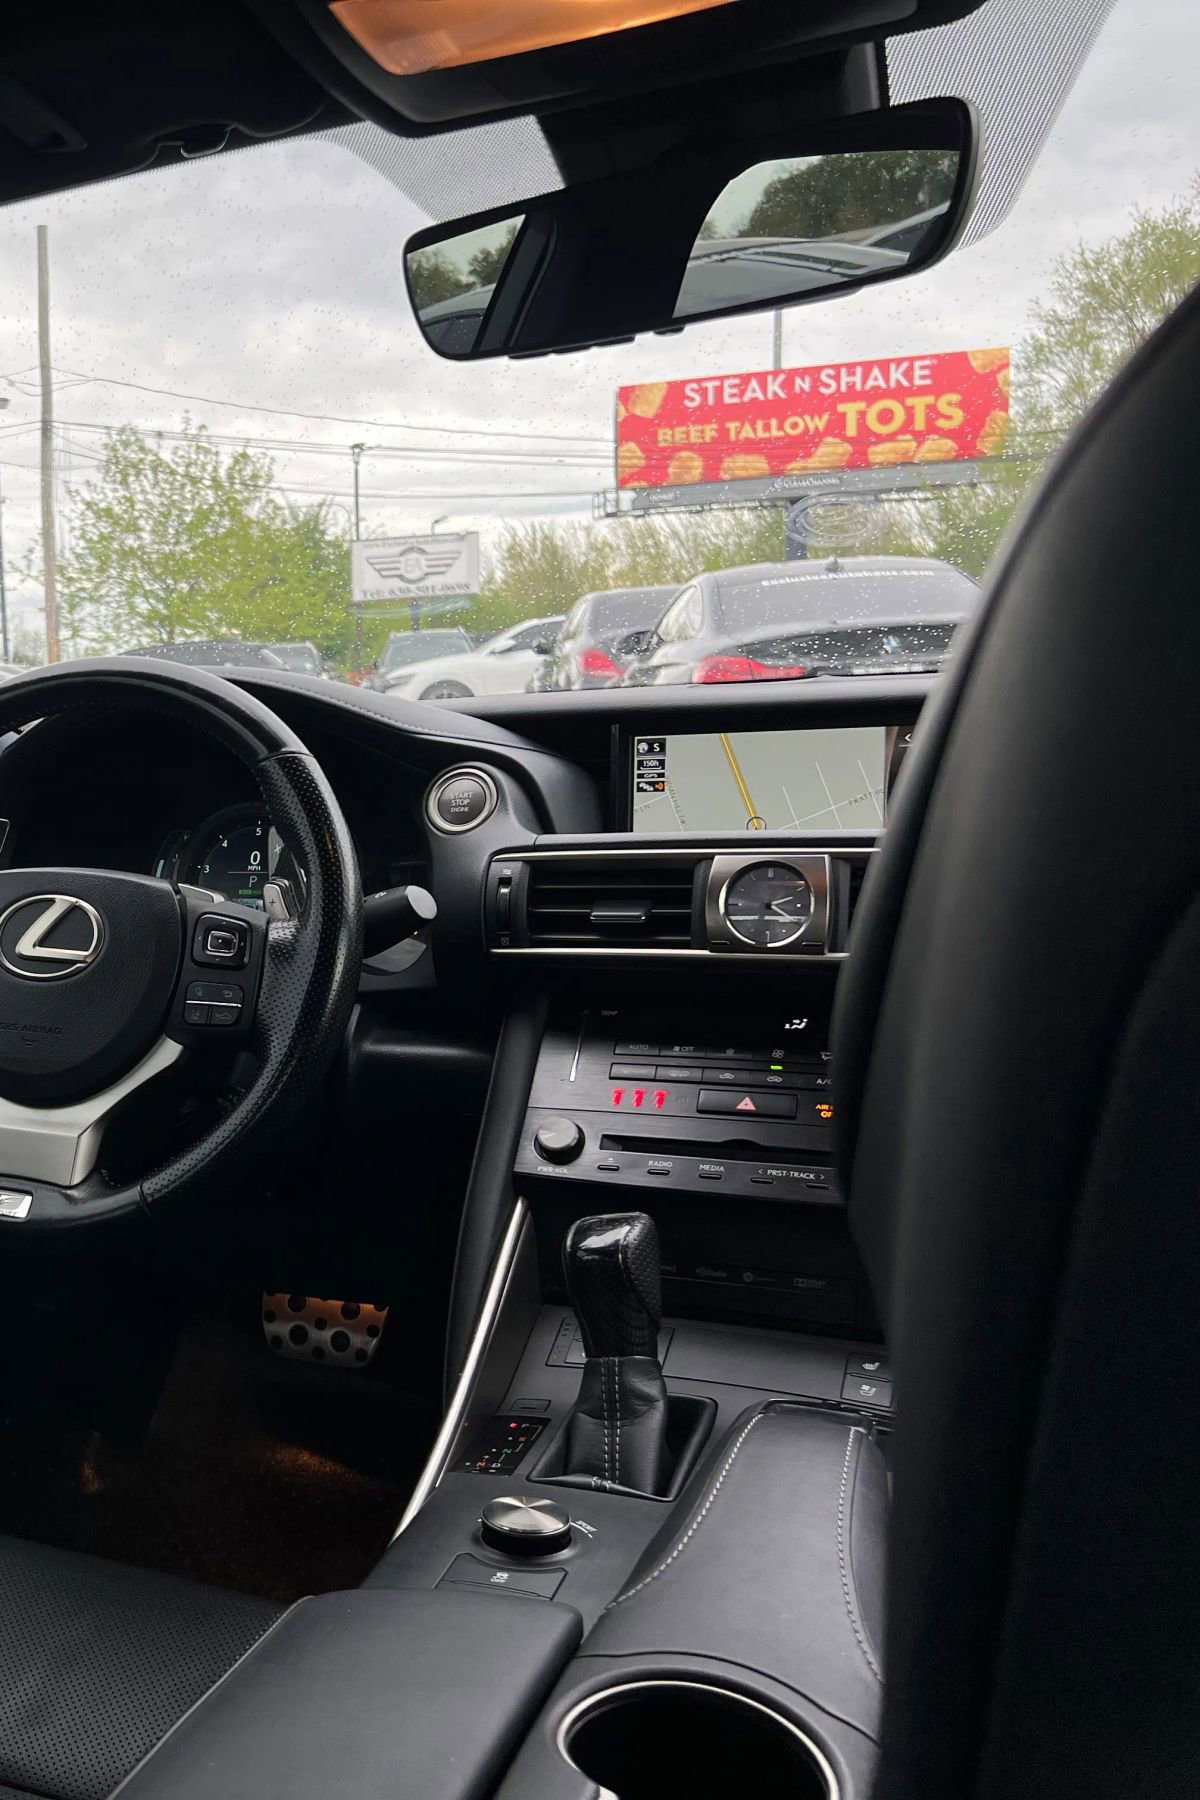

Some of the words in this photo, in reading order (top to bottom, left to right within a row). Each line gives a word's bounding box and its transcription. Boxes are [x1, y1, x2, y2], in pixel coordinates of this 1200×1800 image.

[683, 374, 787, 408] STEAK
[794, 377, 811, 395] N
[819, 359, 934, 397] SHAKE
[657, 424, 718, 447] BEEF
[725, 413, 830, 442] TALLOW
[837, 393, 965, 438] TOTS
[653, 743, 660, 752] S
[450, 791, 473, 799] START
[848, 791, 873, 806] PRATT
[255, 827, 262, 836] 5
[221, 839, 228, 848] 4
[250, 850, 261, 865] 0
[203, 864, 210, 873] 3
[249, 875, 258, 888] P
[648, 1160, 673, 1168] RADIO
[699, 1164, 725, 1172] MEDIA
